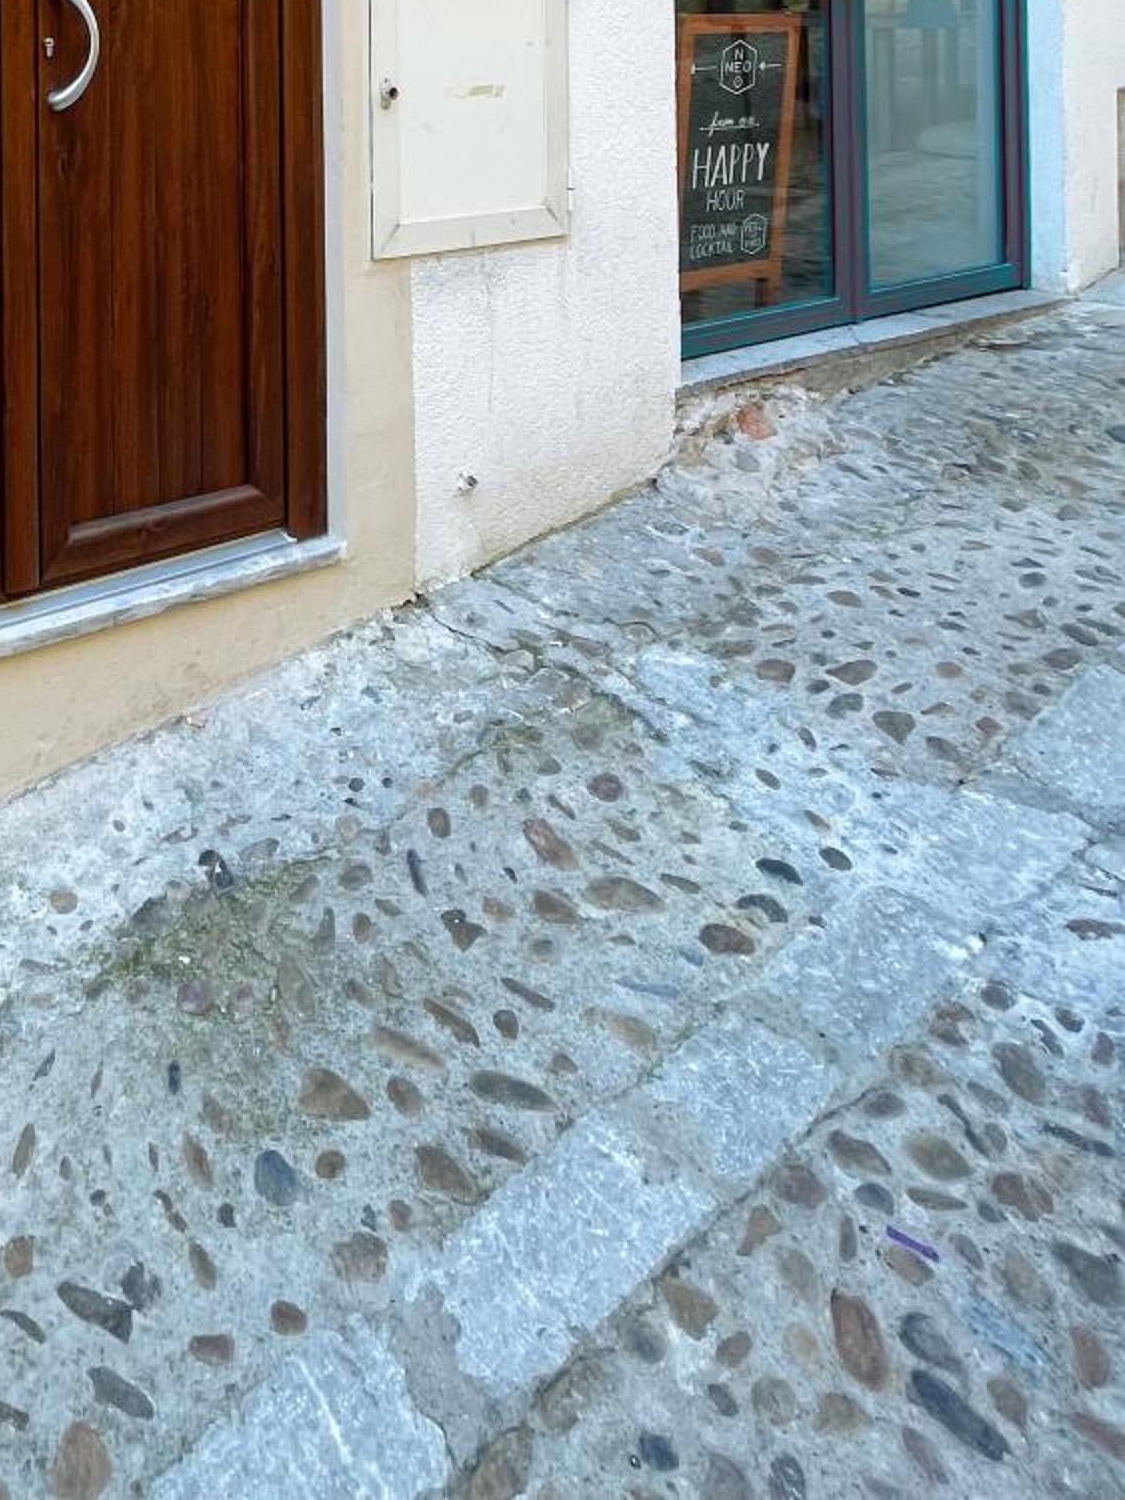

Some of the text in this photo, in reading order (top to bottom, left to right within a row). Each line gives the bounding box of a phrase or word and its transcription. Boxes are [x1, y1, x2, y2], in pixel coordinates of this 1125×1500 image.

[724, 60, 752, 76] NEO
[692, 142, 770, 189] HAPPY
[706, 189, 745, 213] HOUR
